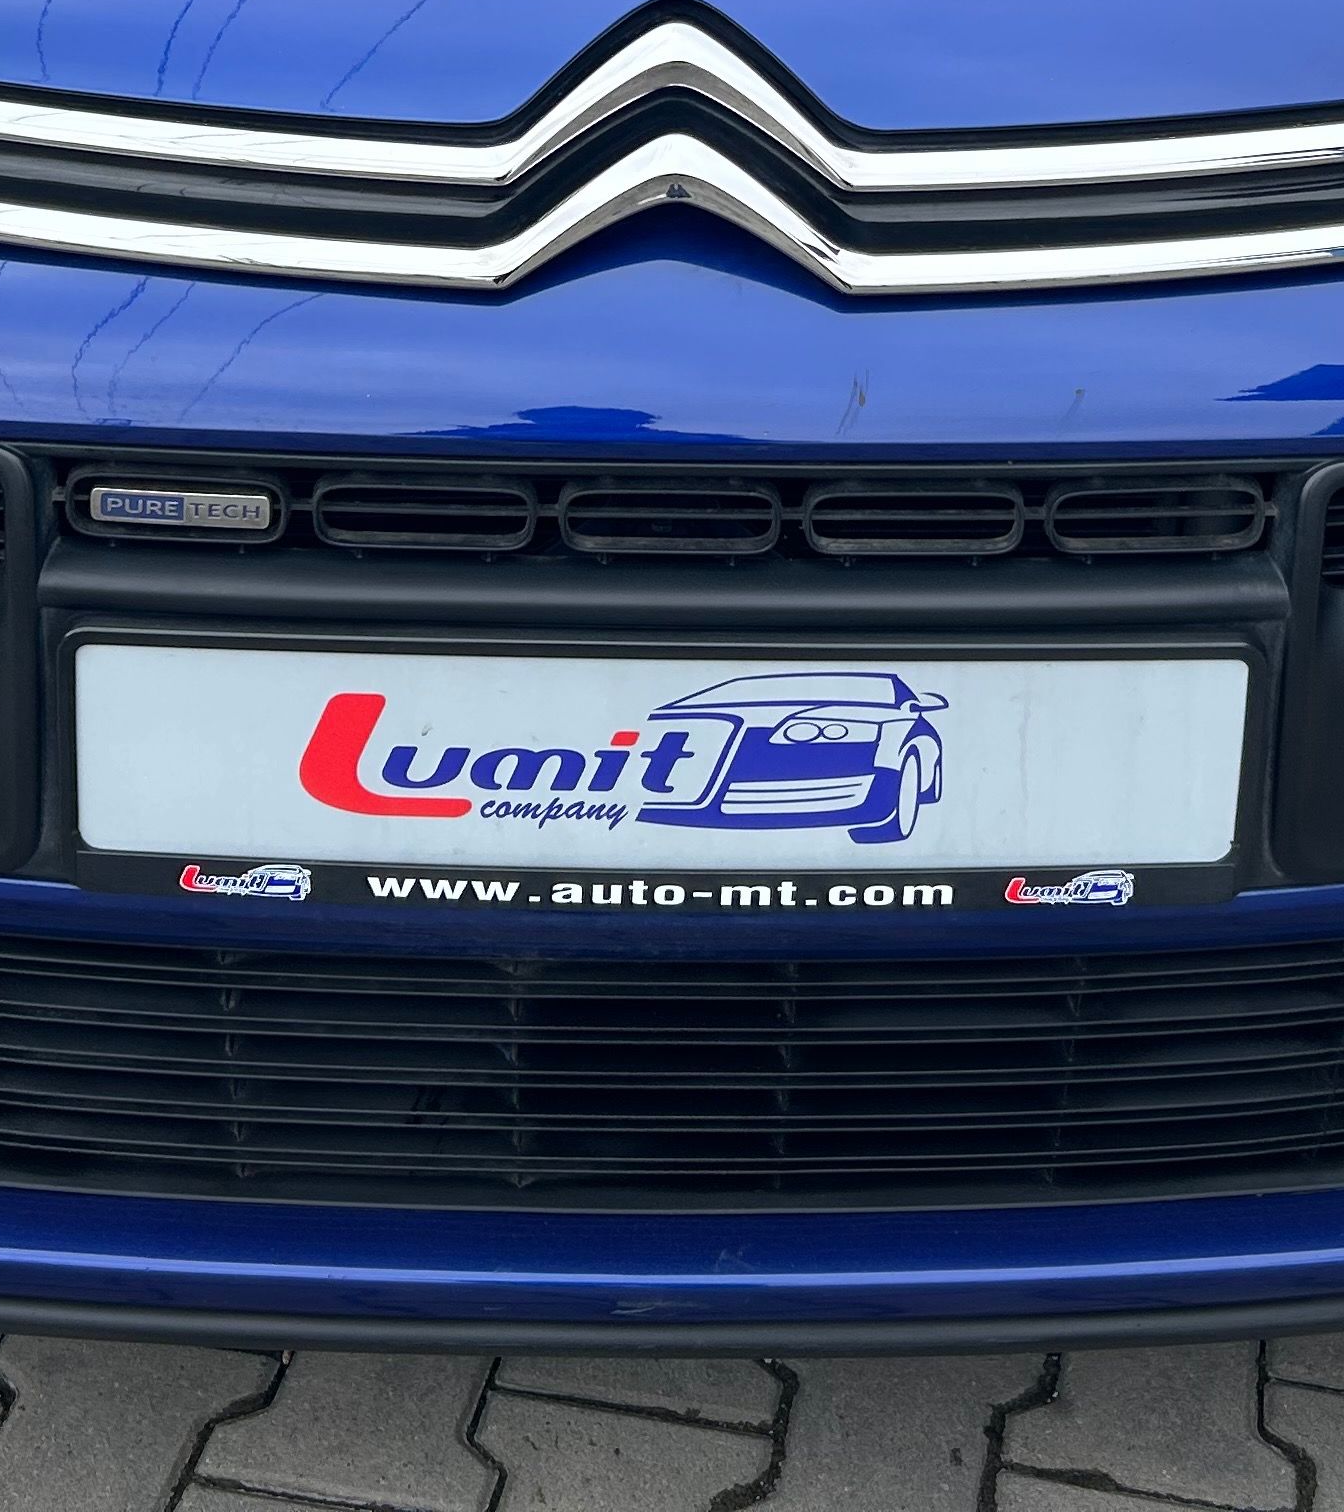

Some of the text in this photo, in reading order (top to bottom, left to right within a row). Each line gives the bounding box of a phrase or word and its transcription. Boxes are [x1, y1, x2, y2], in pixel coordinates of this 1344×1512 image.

[106, 497, 261, 520] PURE TECH
[299, 693, 695, 818] Lumit
[480, 797, 628, 831] company
[367, 875, 955, 907] www.auto-mt.com
